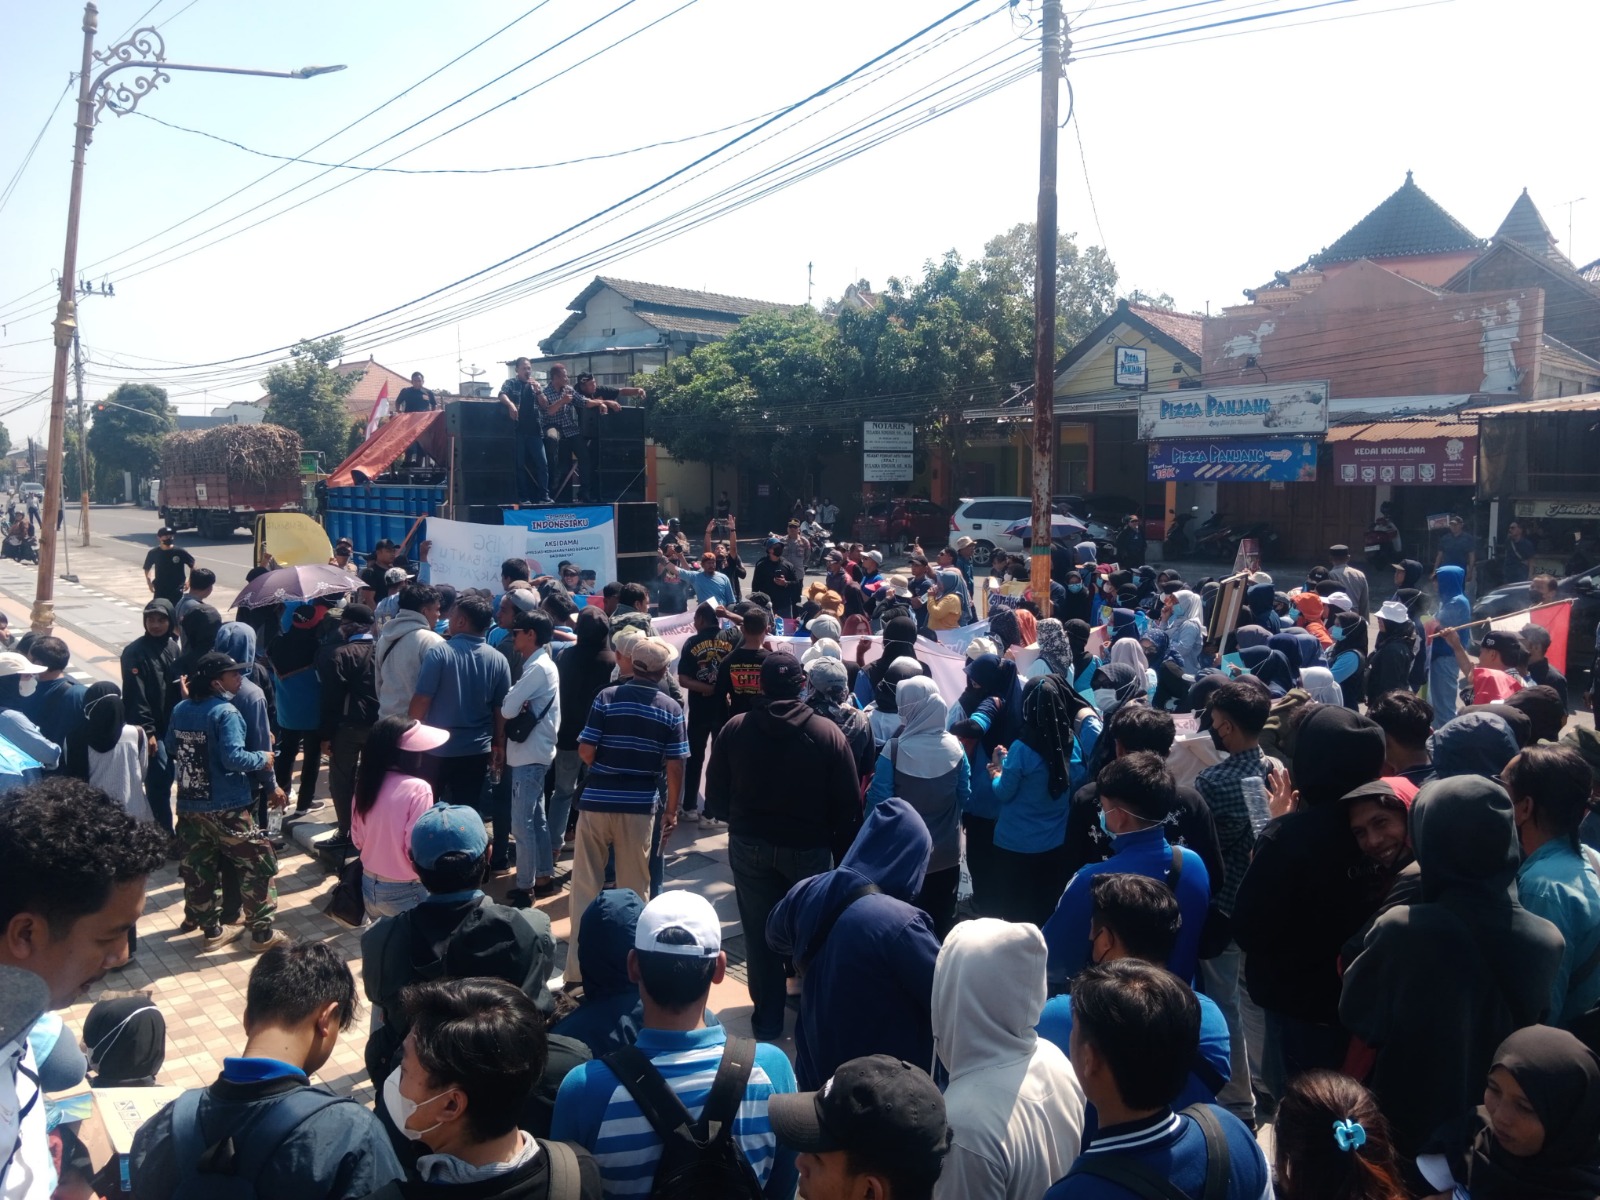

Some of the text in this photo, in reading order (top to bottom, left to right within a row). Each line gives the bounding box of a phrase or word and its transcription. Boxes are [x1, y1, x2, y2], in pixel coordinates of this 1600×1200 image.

[872, 422, 906, 430] NOTARIS
[1354, 447, 1379, 456] KEDAI
[532, 518, 589, 531] INDONESIAKU
